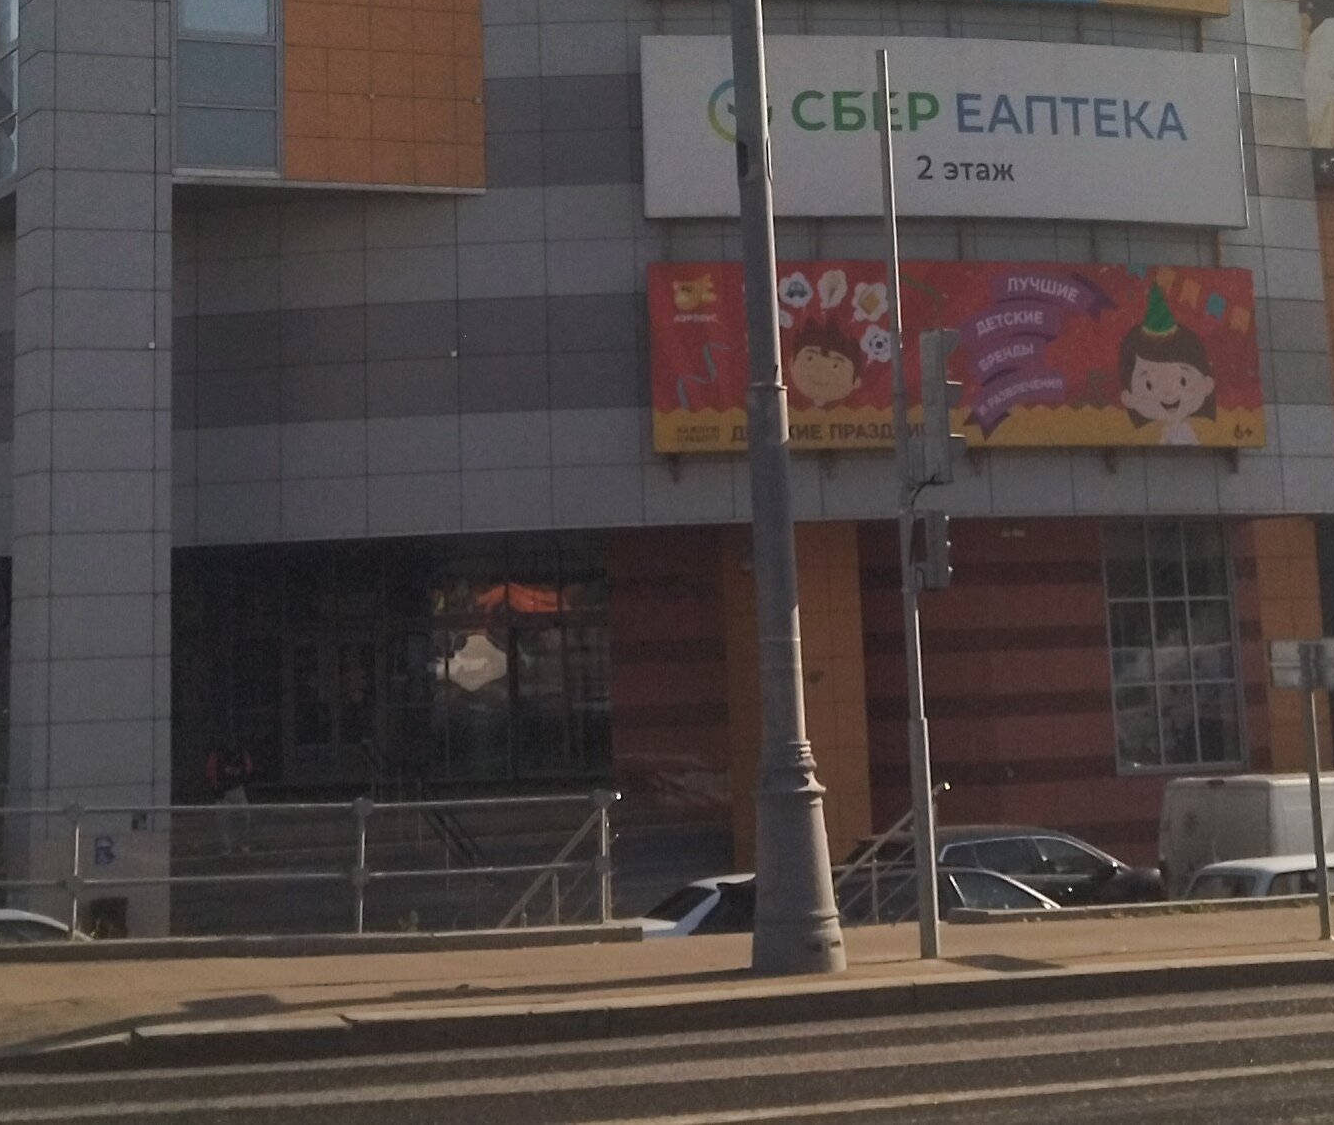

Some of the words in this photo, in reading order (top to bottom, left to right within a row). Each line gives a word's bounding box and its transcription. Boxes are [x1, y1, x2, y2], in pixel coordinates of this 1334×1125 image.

[957, 93, 1188, 141] ЕАПТЕКА
[917, 155, 933, 180] 2
[943, 159, 1015, 182] этаж
[1007, 276, 1079, 303] ЛУЧШИЕ
[976, 310, 1043, 337] ДЕТСКИЕ
[978, 343, 1034, 371] БРЕНДЫ
